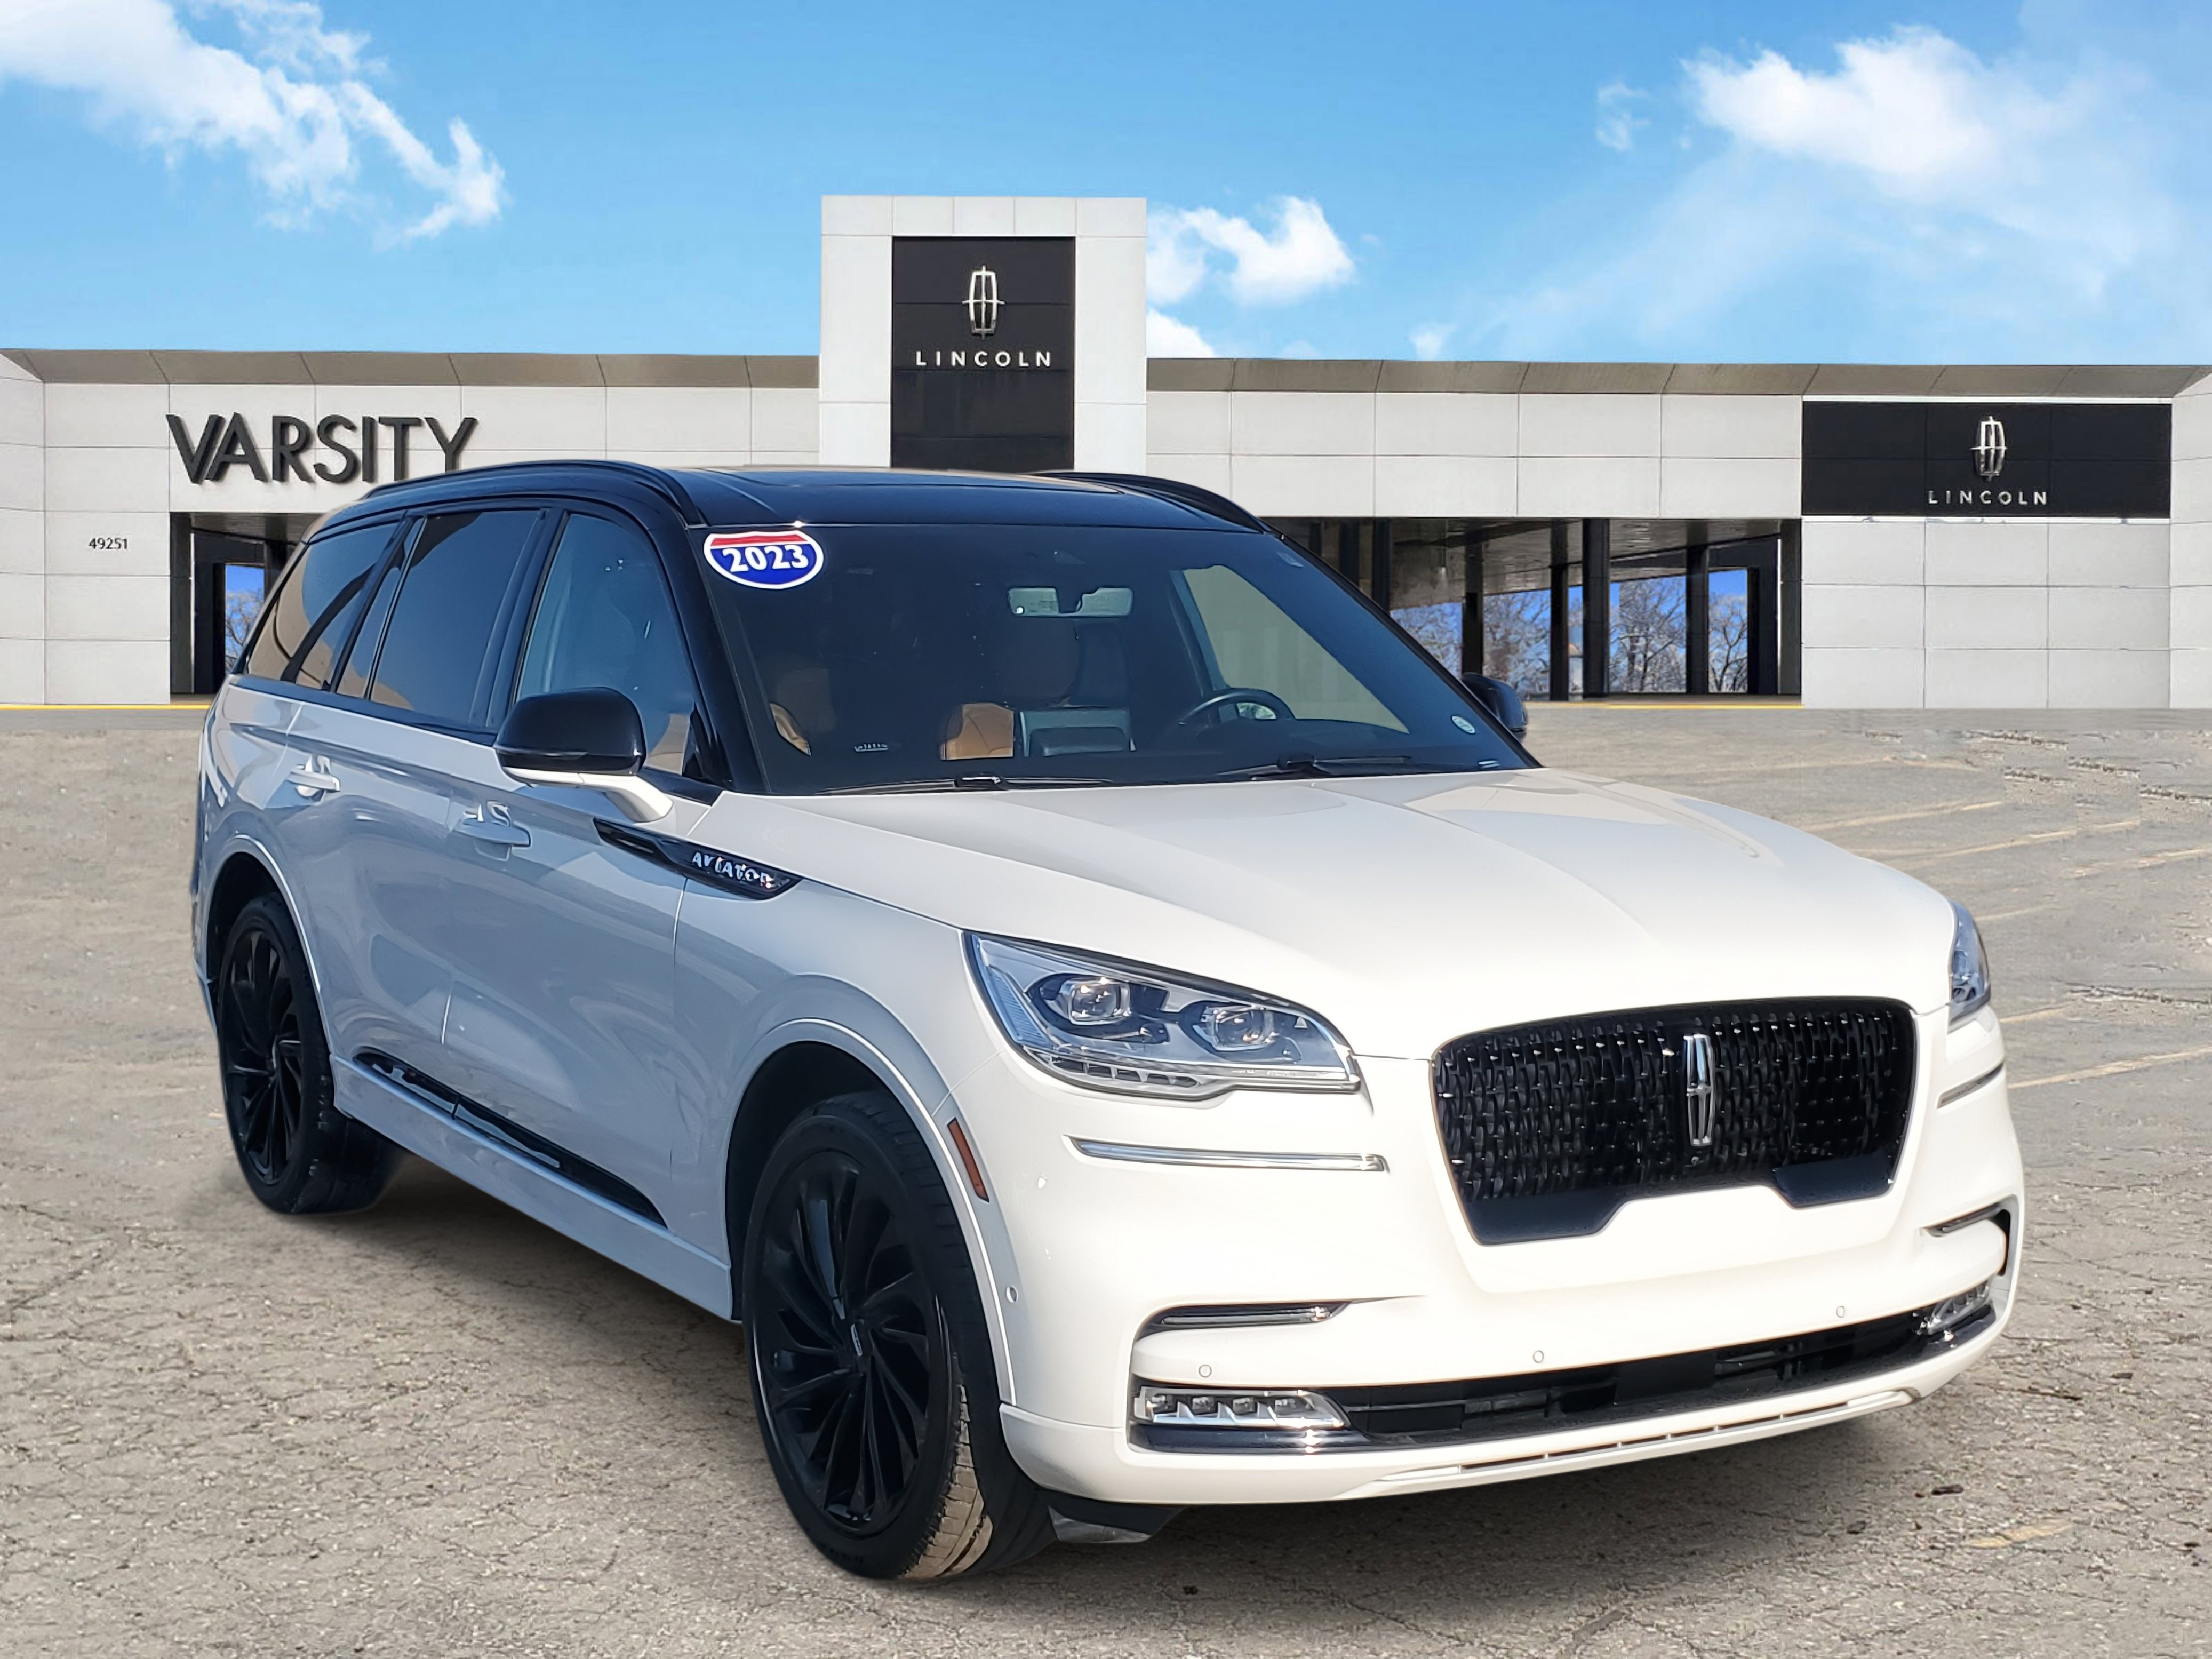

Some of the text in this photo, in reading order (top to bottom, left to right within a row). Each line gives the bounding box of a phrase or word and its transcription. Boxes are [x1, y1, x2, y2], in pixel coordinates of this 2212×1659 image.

[916, 350, 1051, 367] LINCOLN
[166, 412, 479, 484] VARSITY
[1928, 490, 2047, 505] LINCOLN
[89, 537, 127, 549] 49251
[722, 544, 809, 572] 2023
[692, 852, 775, 889] AVIATOR
